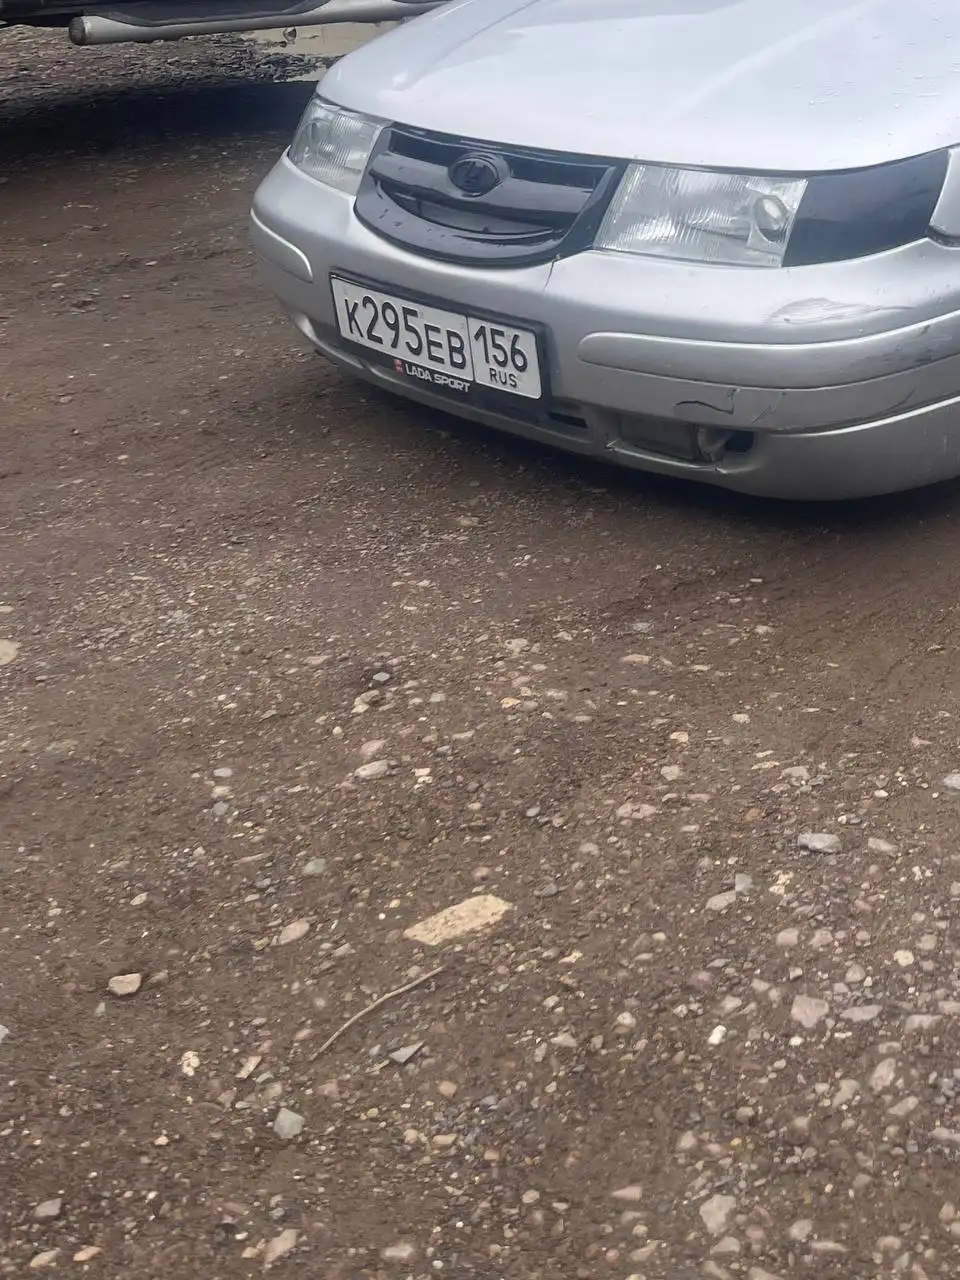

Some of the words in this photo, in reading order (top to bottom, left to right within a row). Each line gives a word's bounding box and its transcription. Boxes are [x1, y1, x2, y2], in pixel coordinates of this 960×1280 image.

[344, 295, 467, 370] К295ЕВ
[473, 325, 528, 372] 156
[405, 363, 433, 382] LADA
[434, 373, 471, 393] SPORT
[489, 367, 518, 388] RUS
